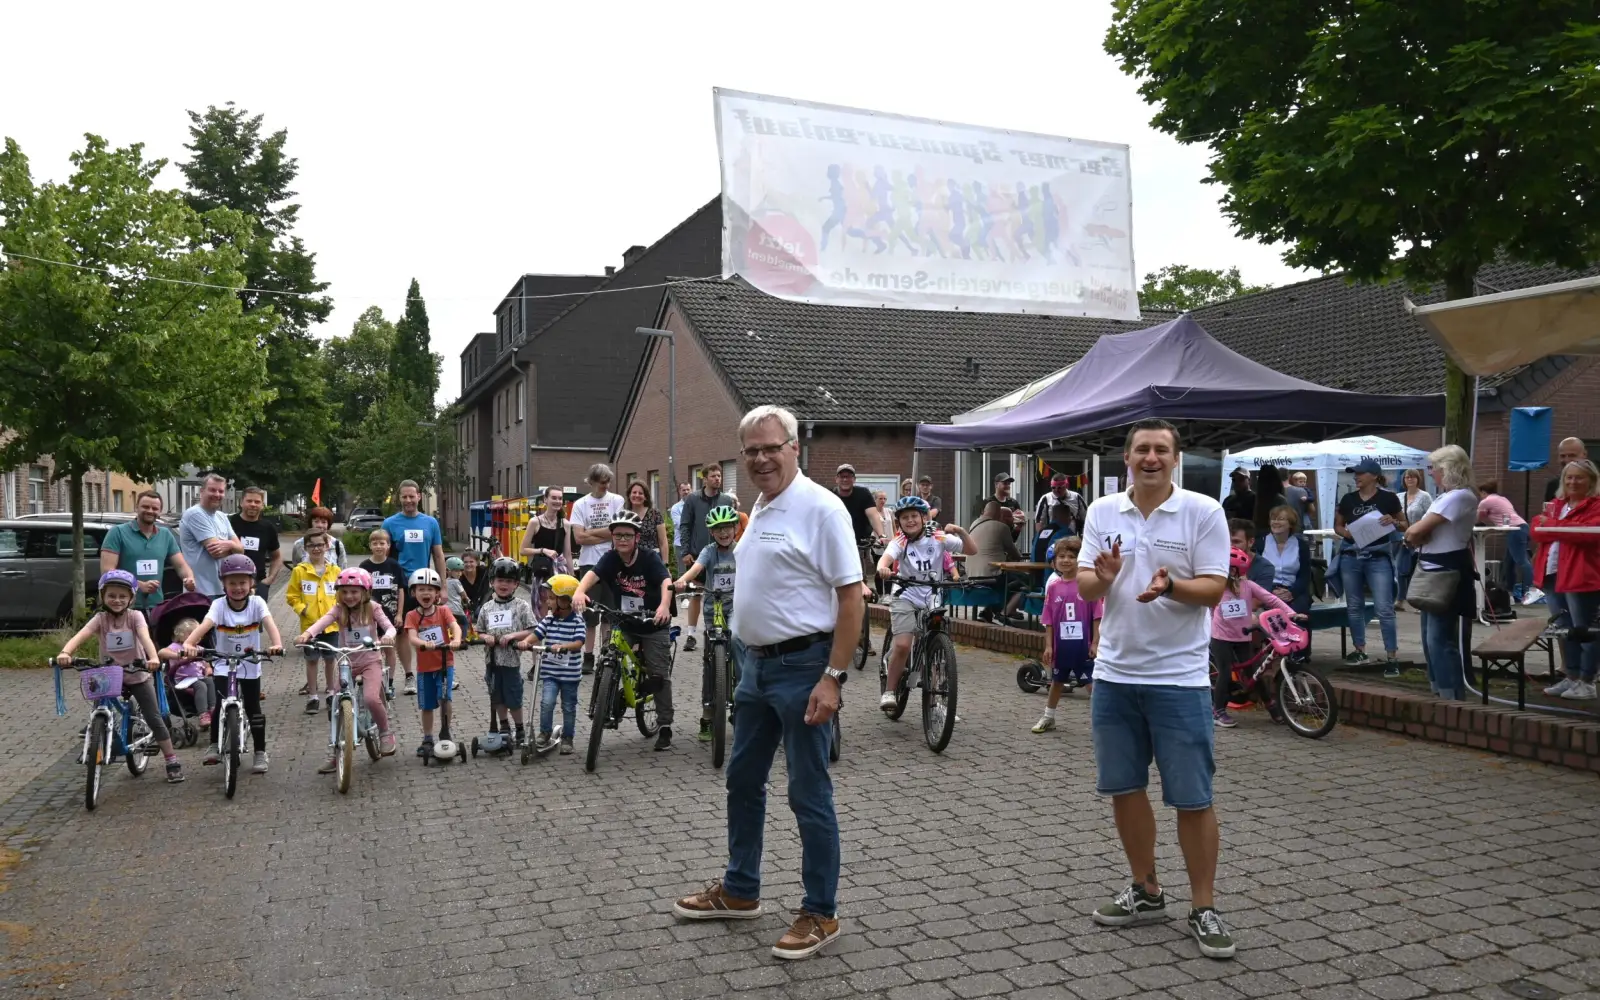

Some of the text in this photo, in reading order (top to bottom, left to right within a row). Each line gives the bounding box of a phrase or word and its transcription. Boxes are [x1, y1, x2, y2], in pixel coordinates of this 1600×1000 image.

[245, 539, 255, 547] 35
[1105, 534, 1123, 549] 14
[143, 563, 153, 571] 11
[375, 578, 385, 586] 40
[720, 578, 731, 586] 34
[1228, 604, 1241, 613] 33
[493, 614, 505, 623] 37
[1065, 624, 1076, 634] 17
[353, 632, 360, 640] 9
[425, 632, 437, 642] 38
[116, 637, 123, 646] 2
[235, 643, 242, 652] 6
